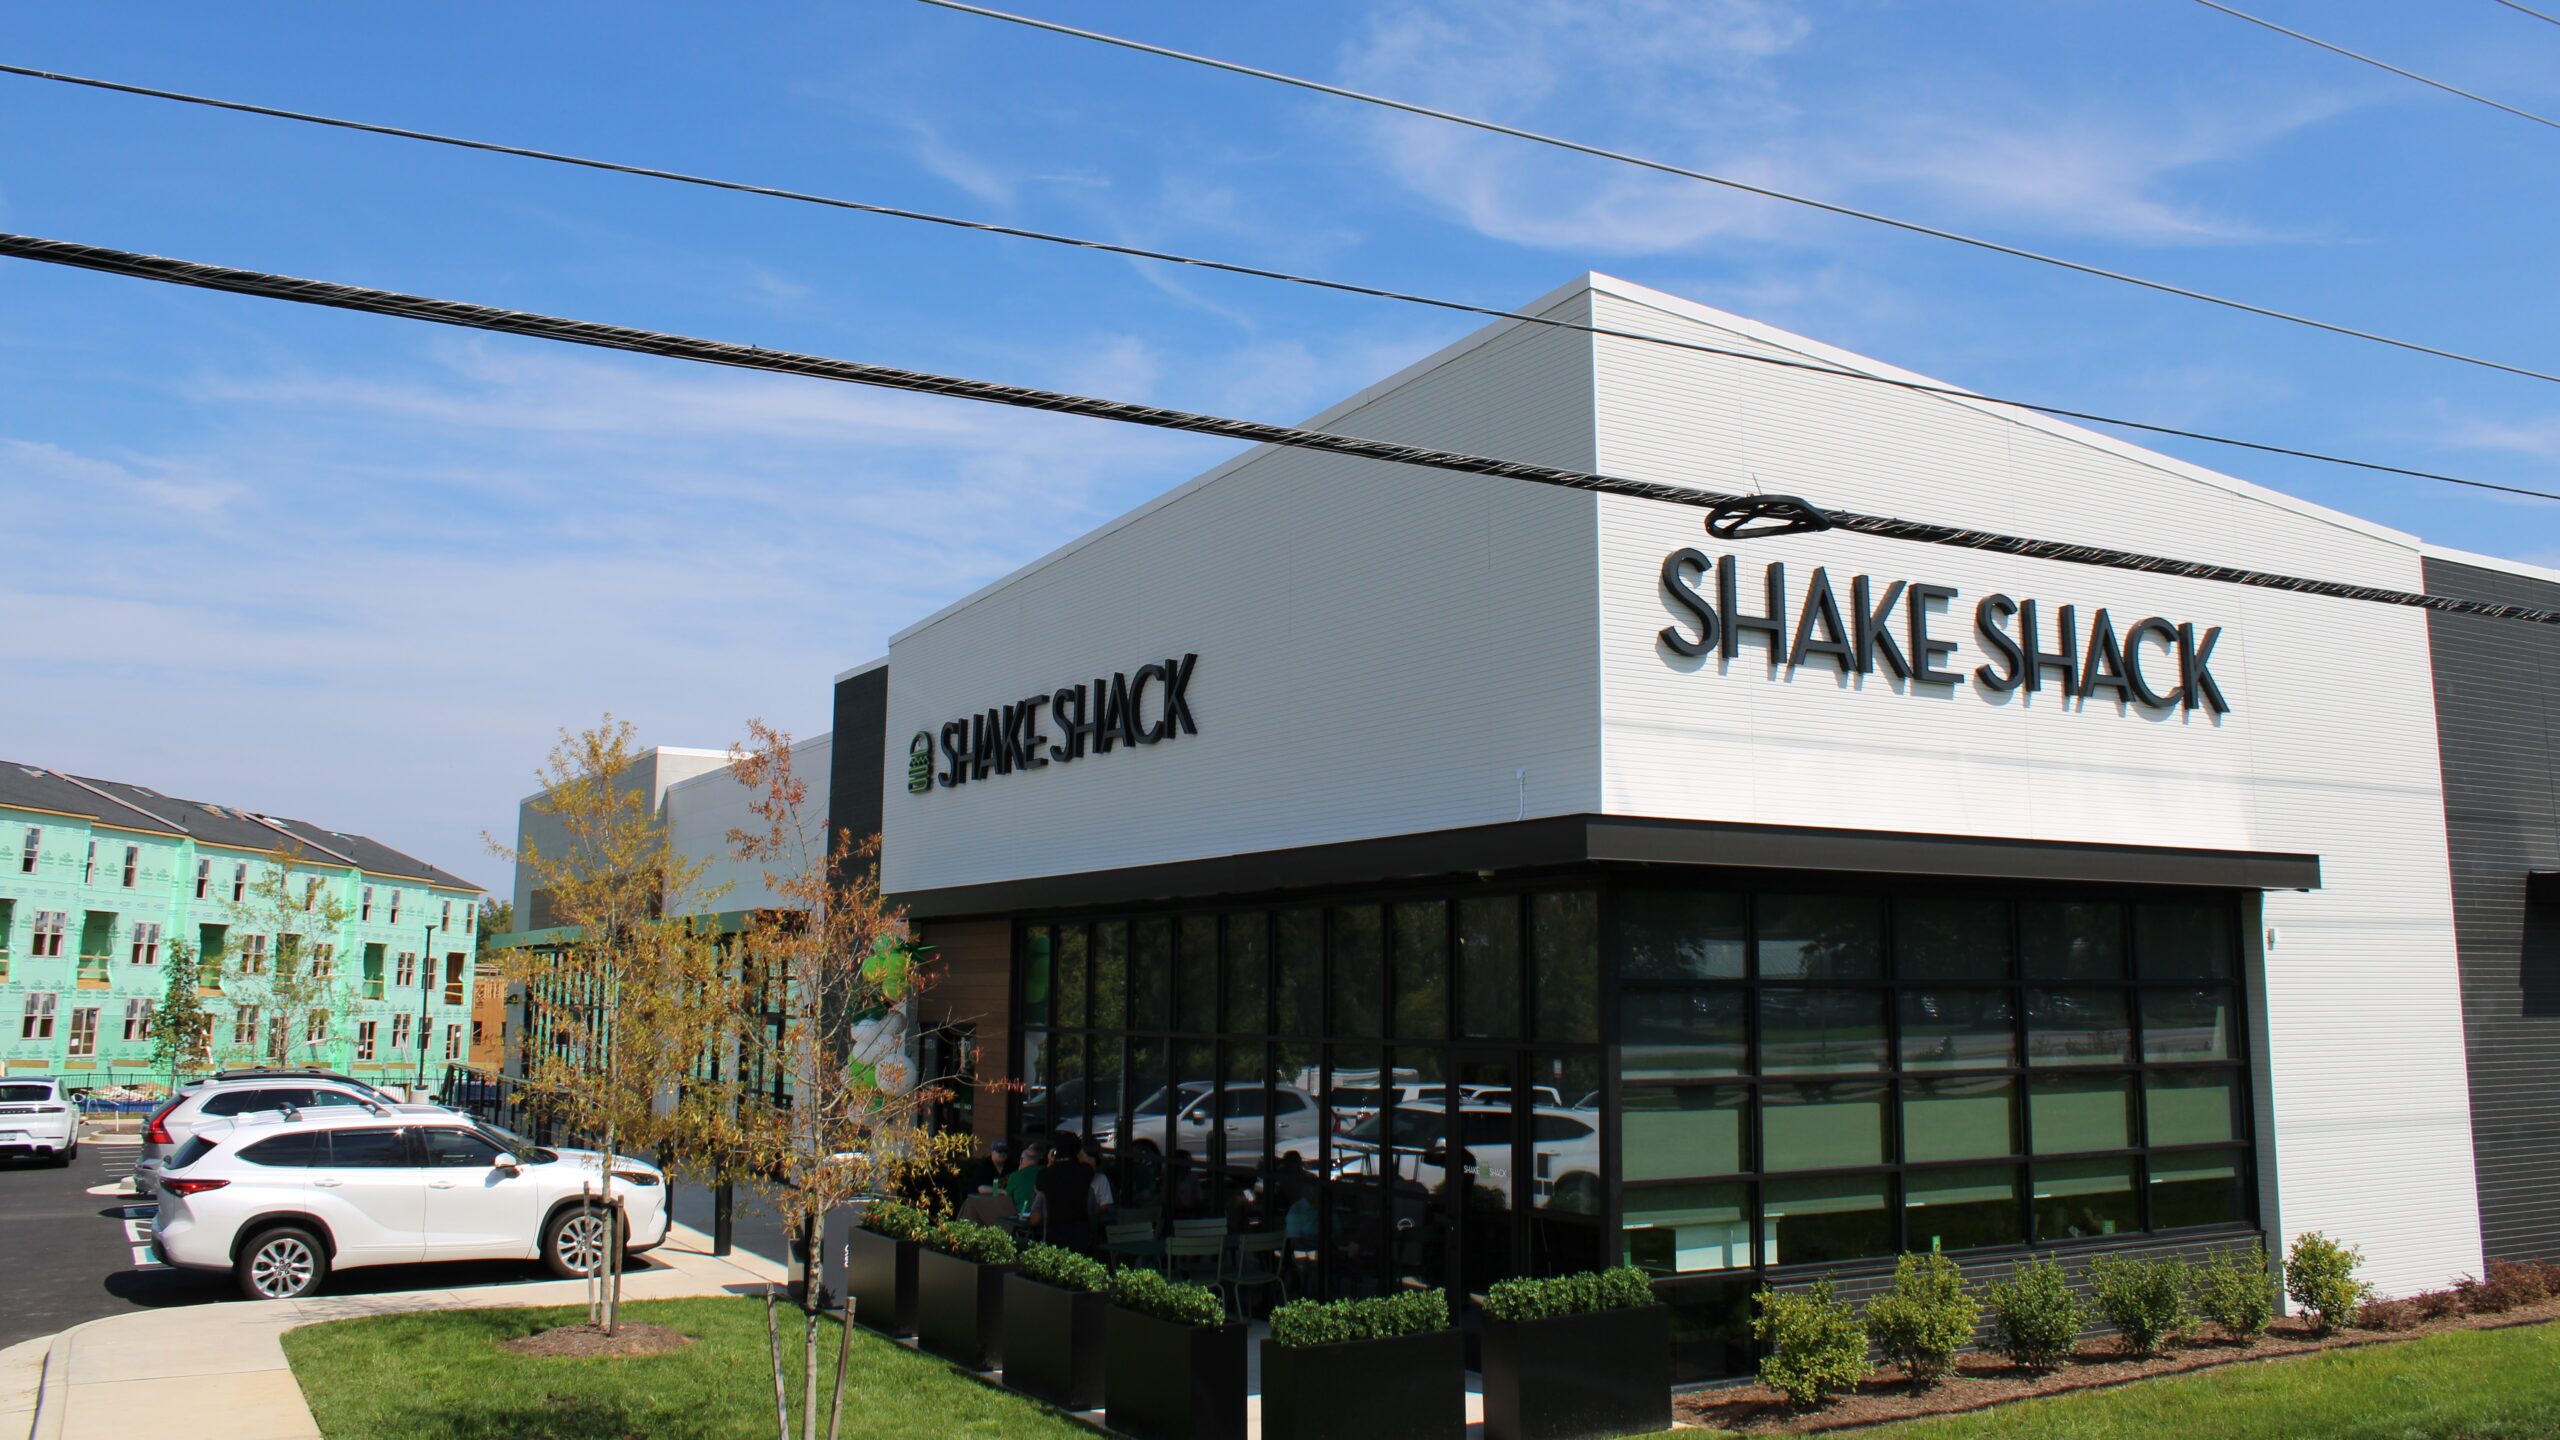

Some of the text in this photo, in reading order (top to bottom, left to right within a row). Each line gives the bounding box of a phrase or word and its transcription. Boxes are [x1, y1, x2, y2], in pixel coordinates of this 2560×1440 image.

[1658, 547, 2231, 714] SHAKE SHACK
[938, 653, 1198, 788] SHAKE SHACK
[1463, 1164, 1507, 1177] SHAKE SHACK
